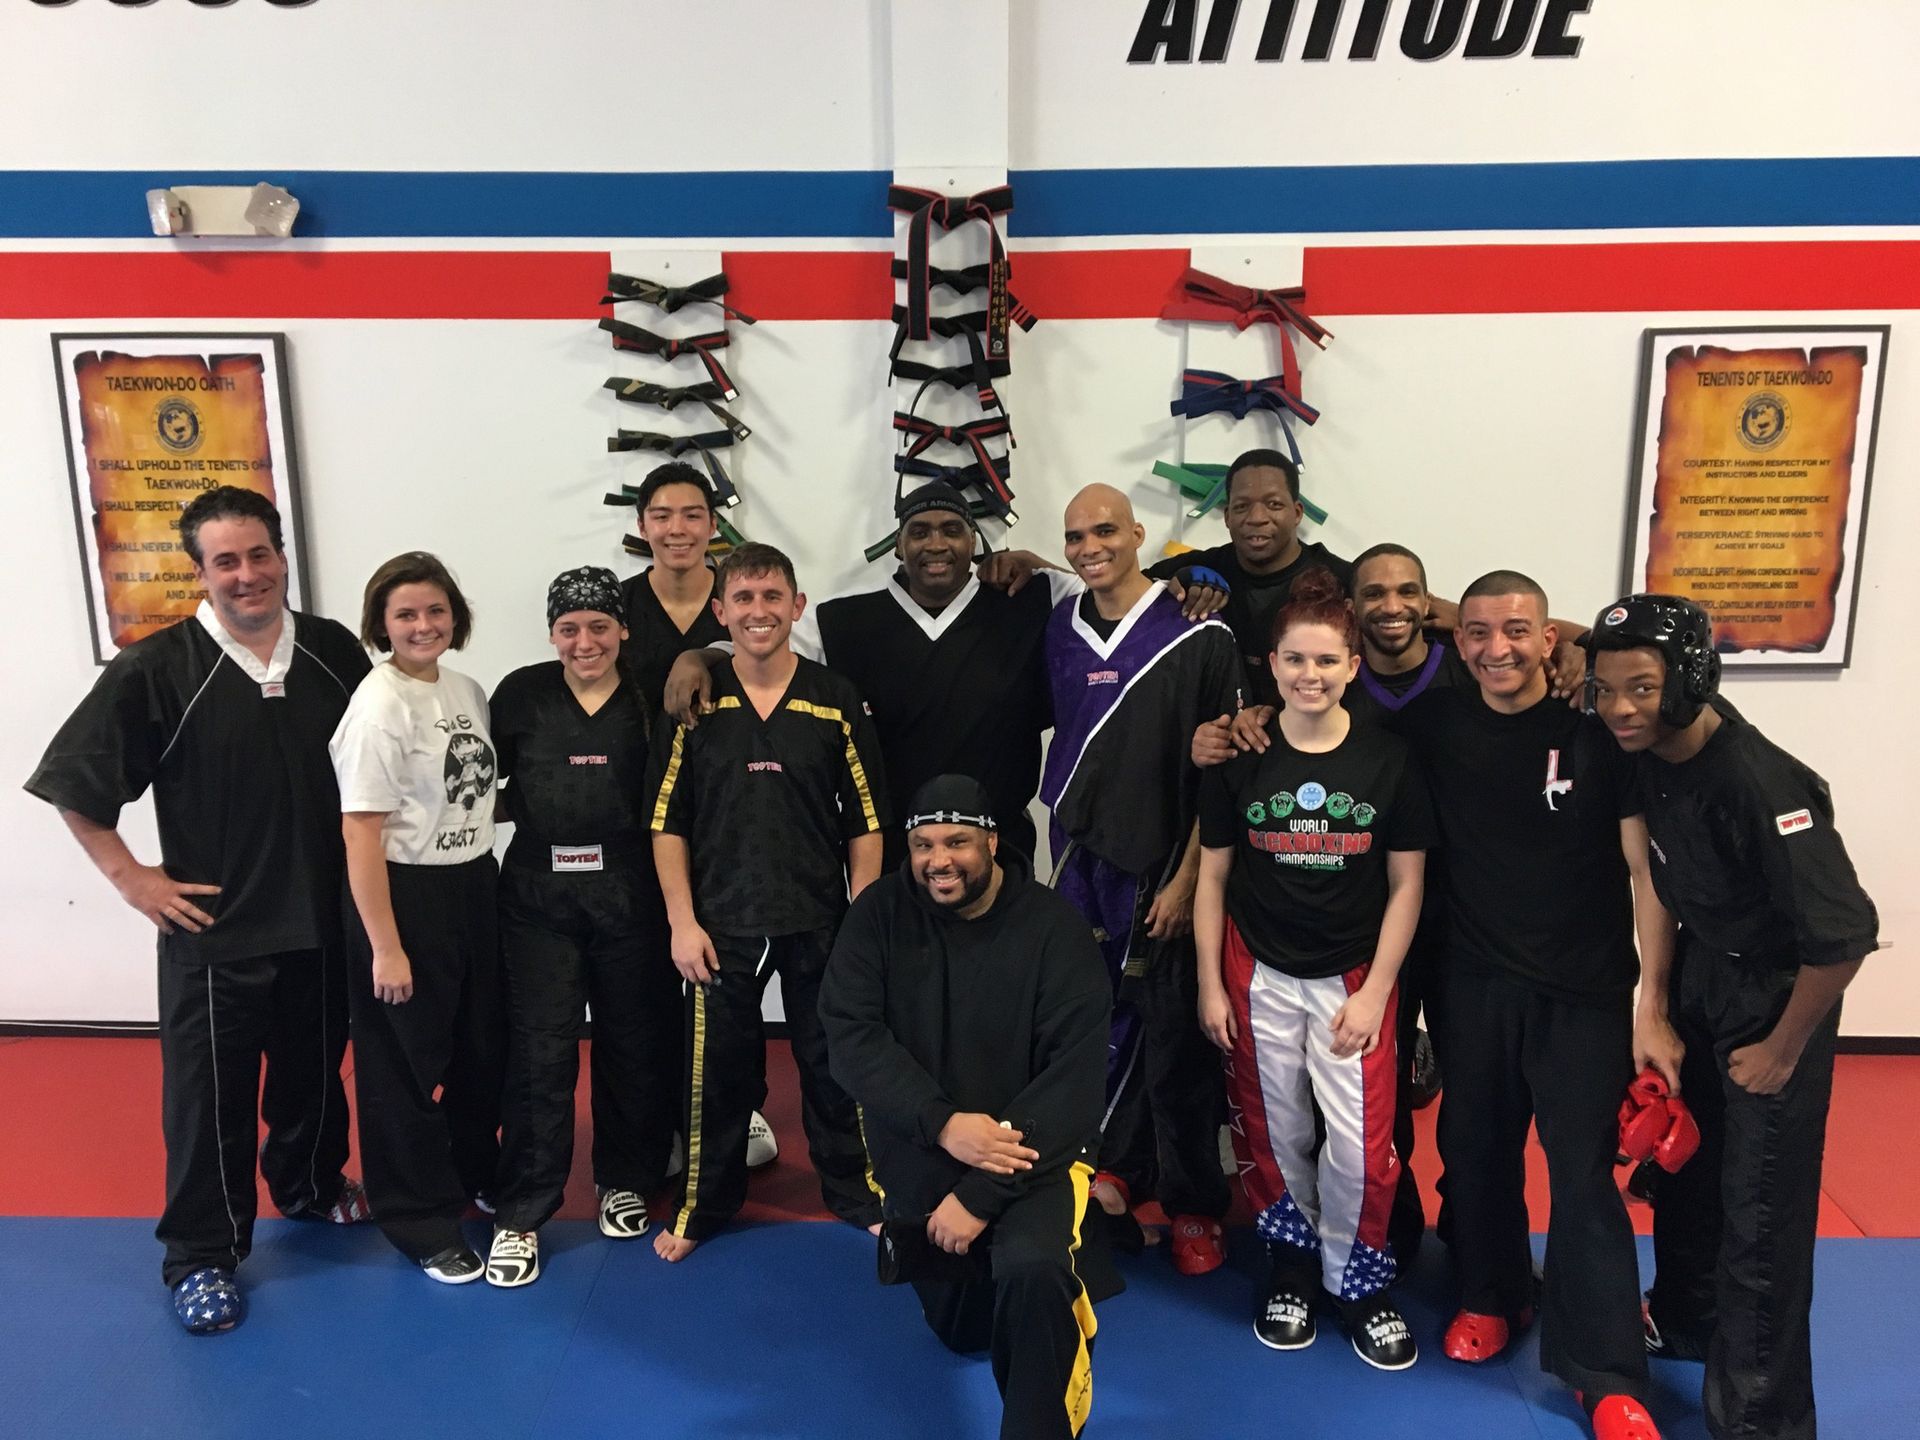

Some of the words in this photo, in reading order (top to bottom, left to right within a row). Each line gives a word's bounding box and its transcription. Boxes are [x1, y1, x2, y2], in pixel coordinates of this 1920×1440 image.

[1697, 371, 1745, 386] TENENTS
[1747, 371, 1762, 386] OF
[1763, 370, 1833, 386] TAEKWON-DO
[105, 376, 197, 392] TAEKWON-DO
[199, 376, 235, 392] OATH
[100, 460, 134, 471] SHALL
[136, 460, 181, 471] UPHOLD
[183, 460, 206, 471] THE
[207, 460, 250, 471] TENETS
[1765, 459, 1800, 467] RESPECT
[1801, 459, 1818, 467] FOR
[1819, 459, 1831, 467] MY
[1705, 471, 1758, 479] INSTRUCTORS
[1777, 470, 1808, 478] ELDERS
[1766, 496, 1781, 504] THE
[104, 501, 134, 511] SHALL
[135, 501, 175, 511] RESPECT
[1699, 509, 1736, 517] BETWEEN
[142, 542, 173, 552] NEVER
[114, 572, 137, 582] WILL
[138, 572, 152, 582] BE
[153, 572, 160, 582] A
[162, 572, 198, 582] CHAMP
[165, 590, 186, 600] AND
[188, 590, 209, 600] JUST
[1289, 819, 1329, 833] WORLD
[1248, 828, 1373, 855] KICKBOXING
[1275, 853, 1345, 866] CHAMPIONSHIPS
